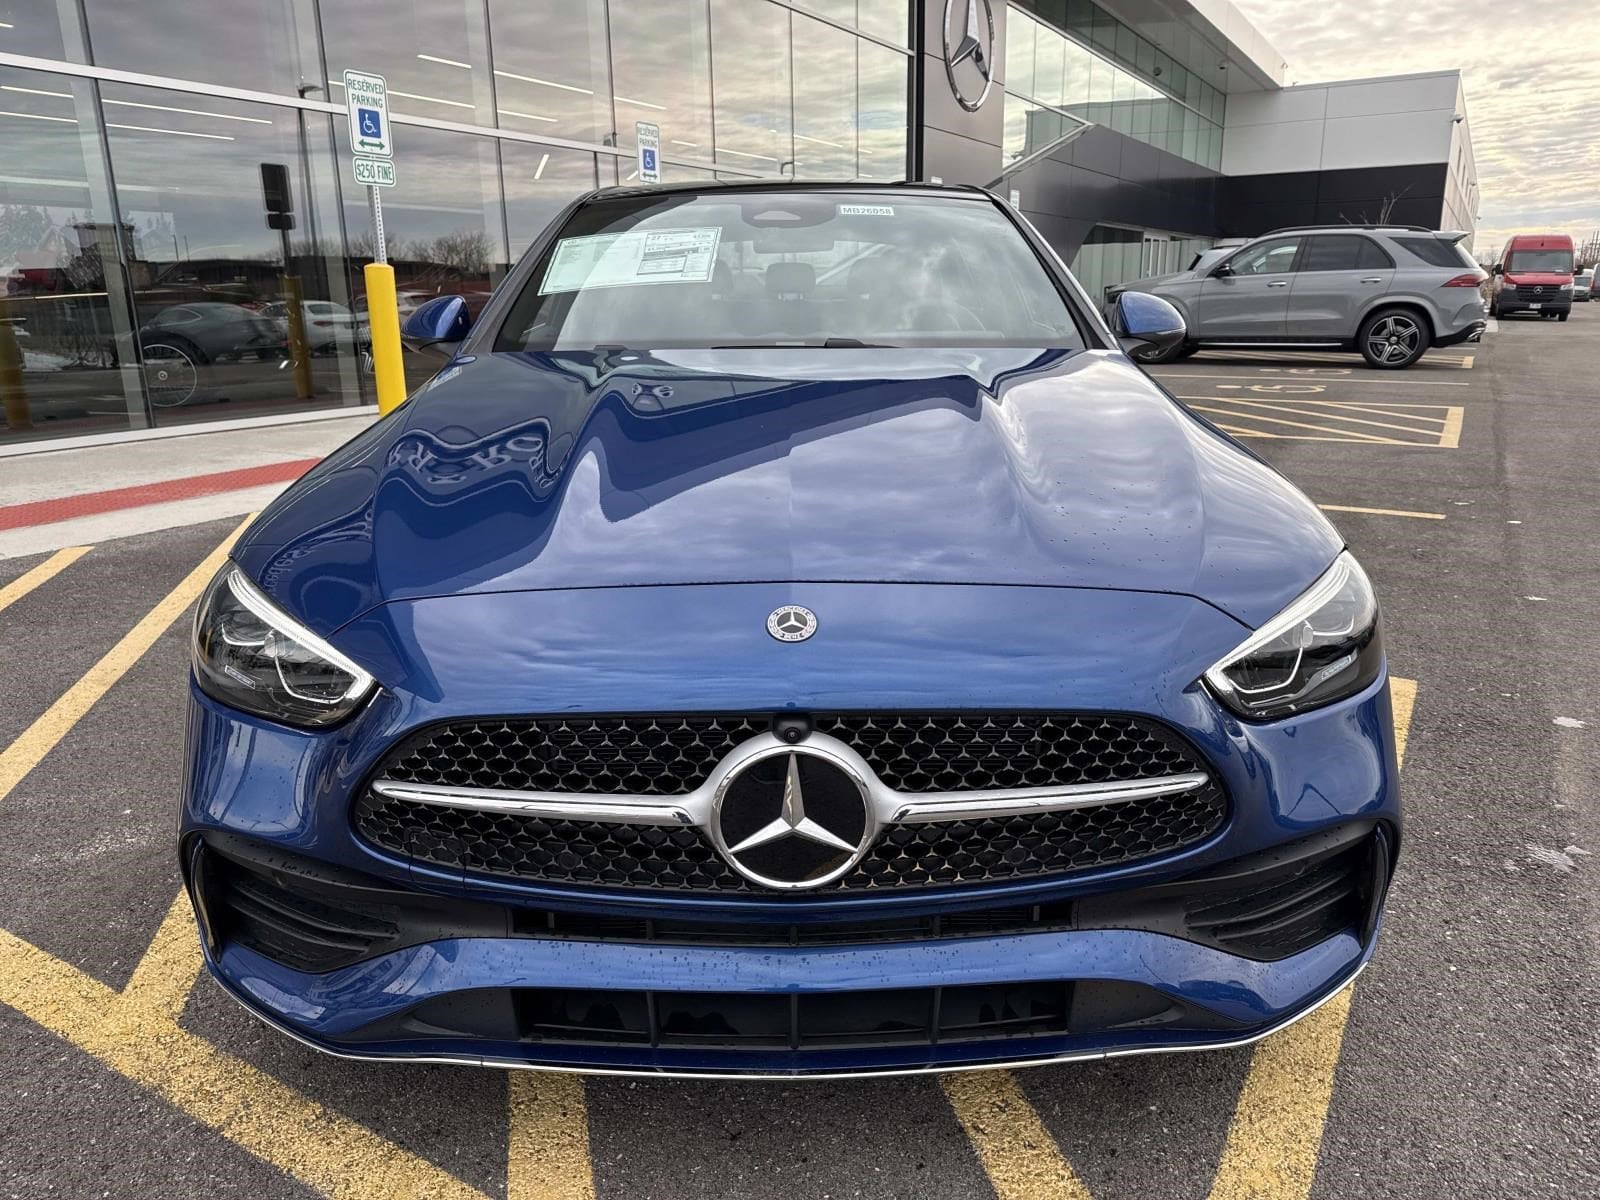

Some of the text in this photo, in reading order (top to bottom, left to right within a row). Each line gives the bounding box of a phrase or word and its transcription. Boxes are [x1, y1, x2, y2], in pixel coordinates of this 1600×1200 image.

[347, 79, 384, 95] RESERVED
[351, 94, 383, 108] PARKING
[356, 163, 393, 181] $250 FINE
